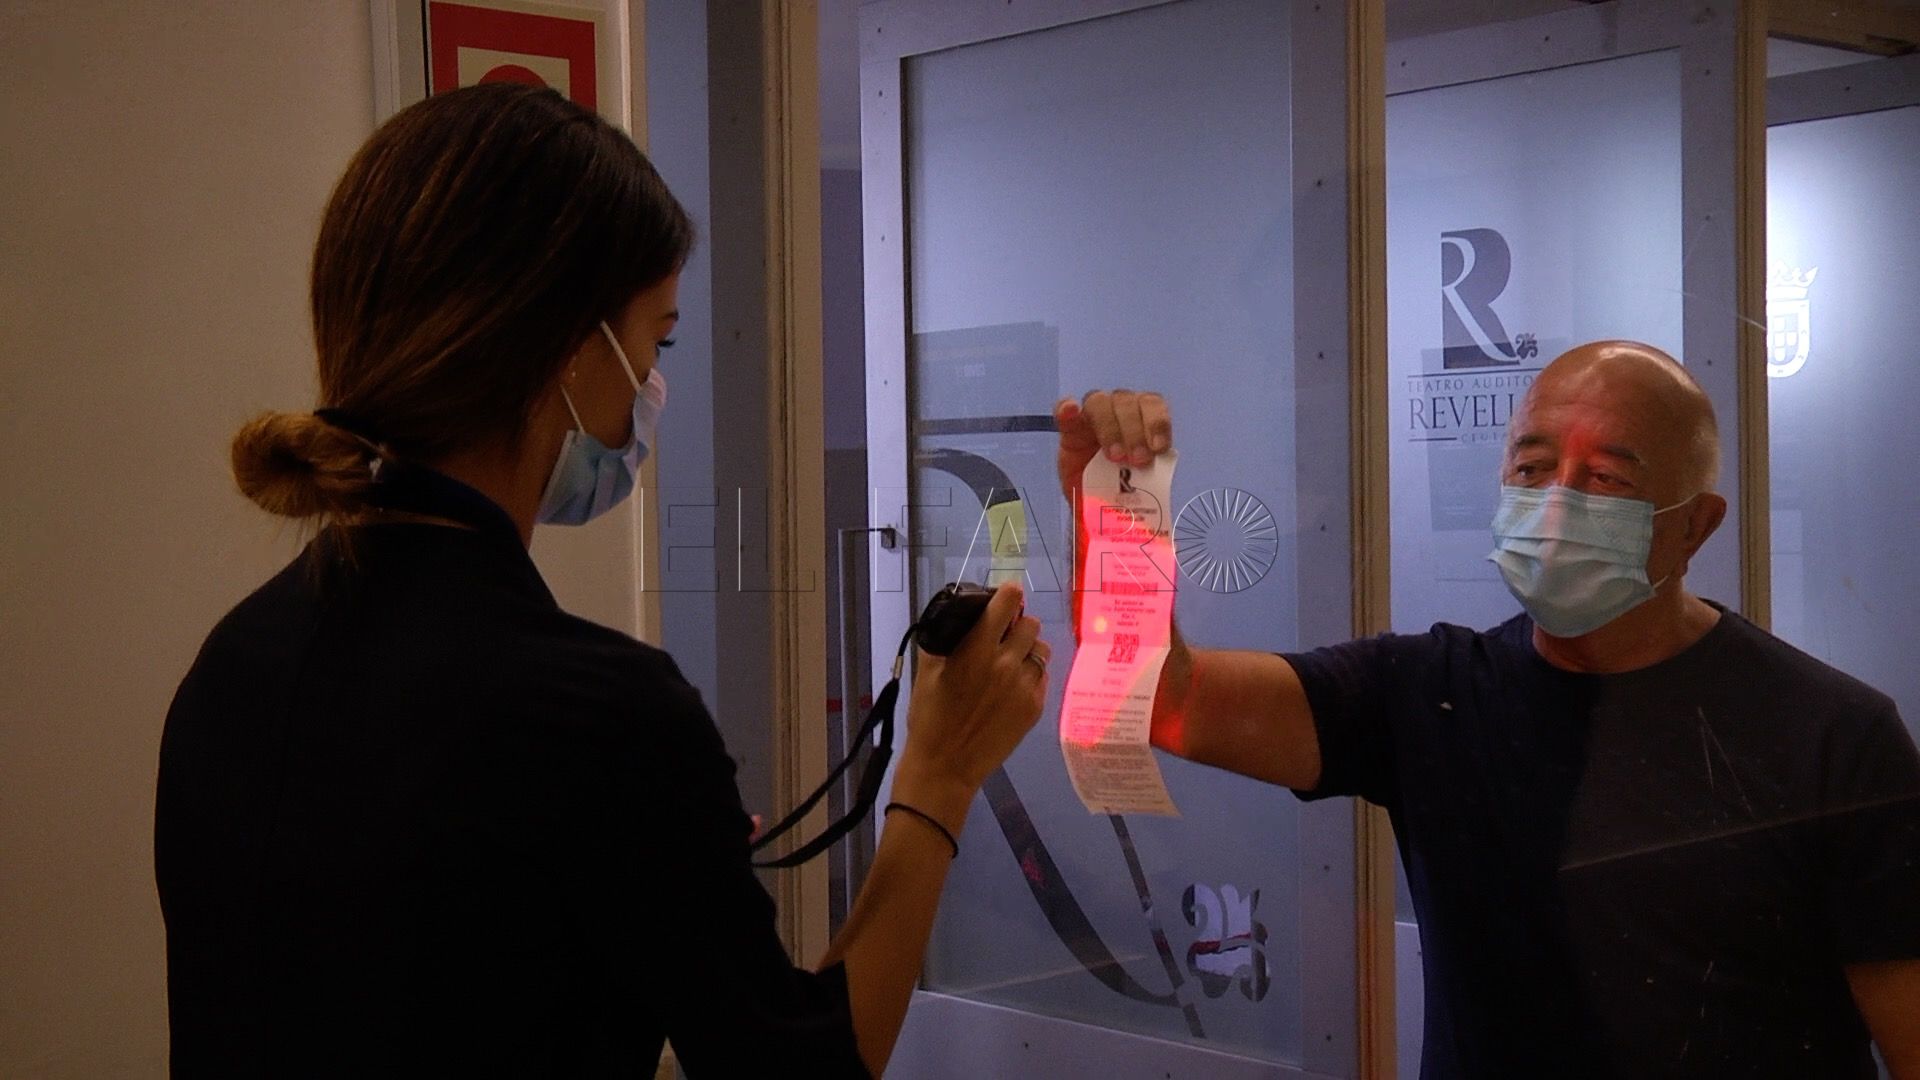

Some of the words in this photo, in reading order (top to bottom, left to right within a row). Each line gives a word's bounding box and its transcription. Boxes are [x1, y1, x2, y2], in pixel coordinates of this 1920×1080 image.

[1407, 378, 1464, 393] TEATRO
[1471, 374, 1533, 389] AUDITO
[1408, 392, 1515, 430] REVEL
